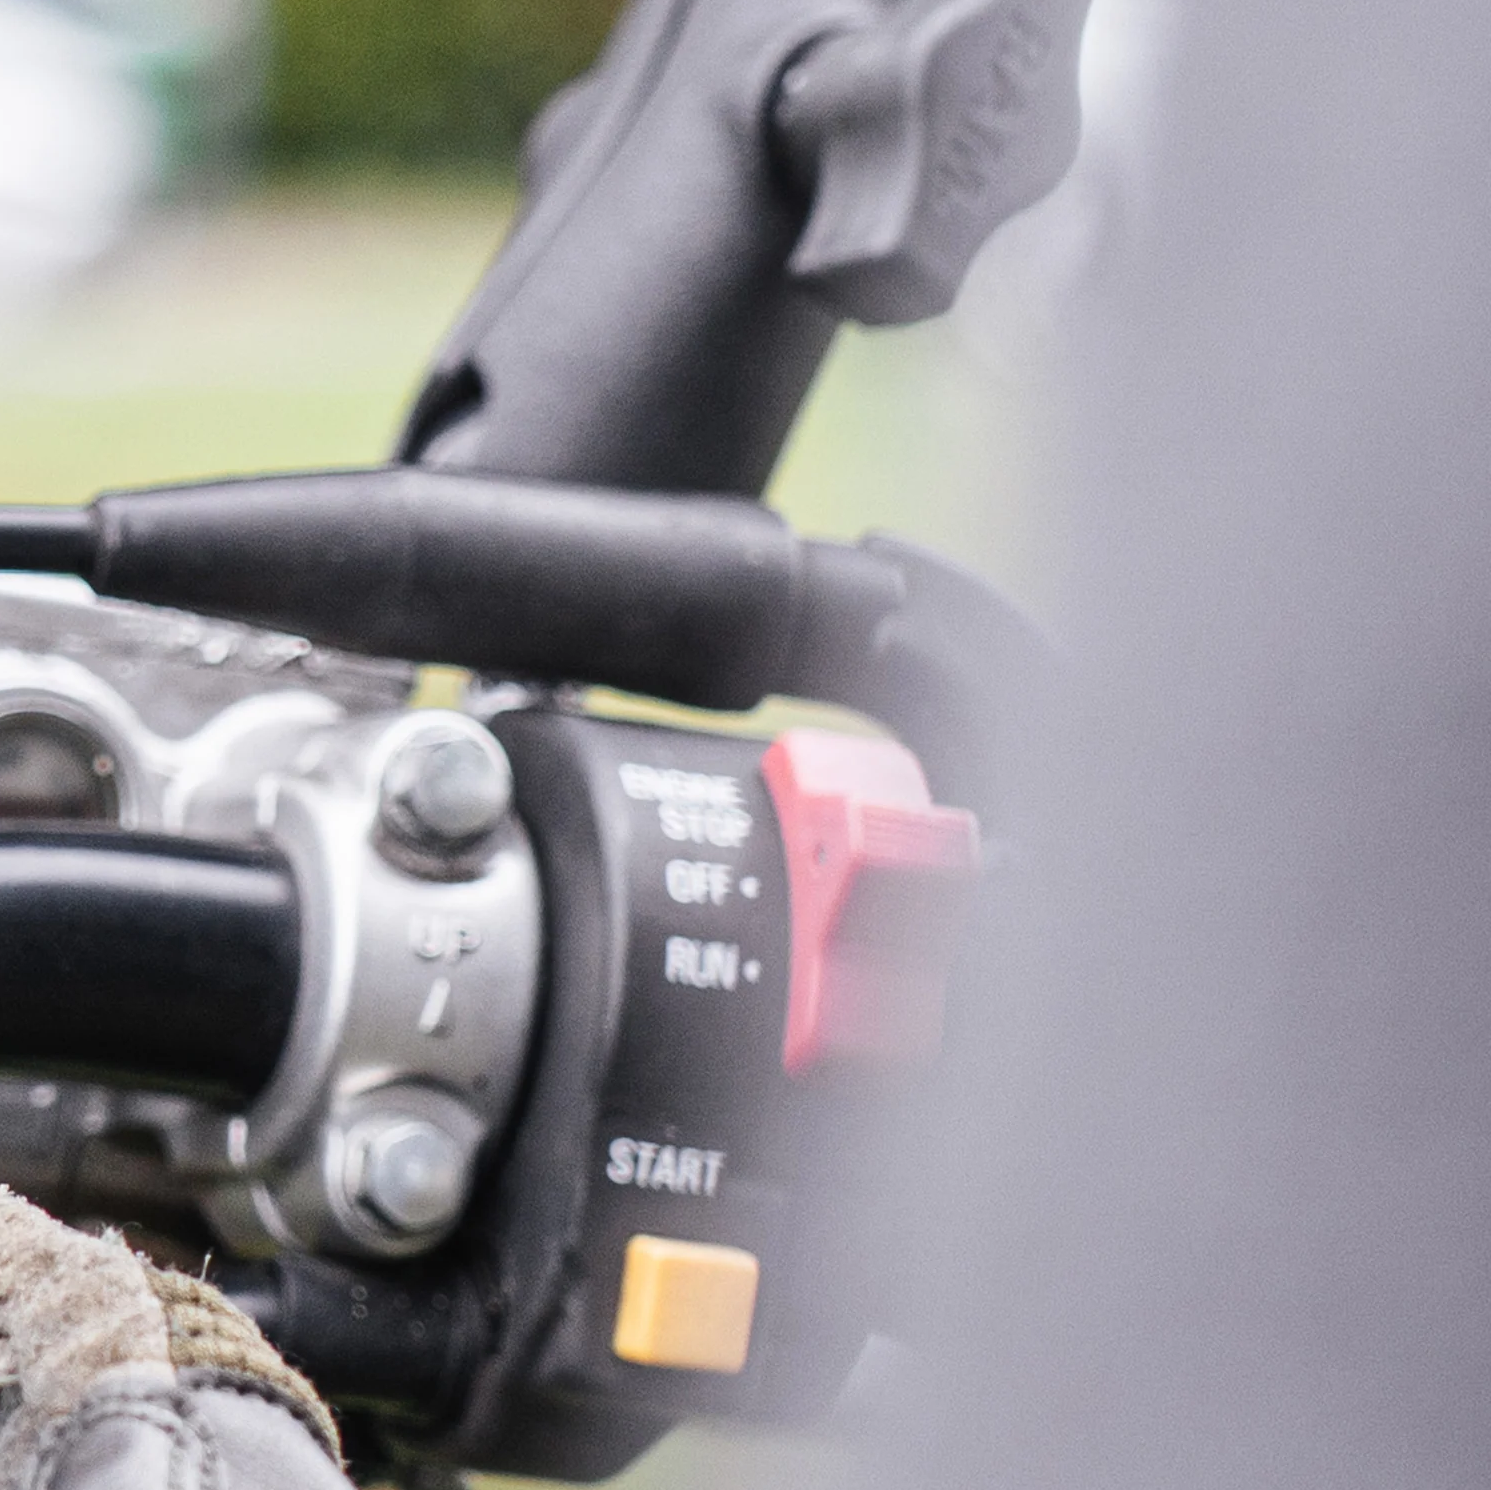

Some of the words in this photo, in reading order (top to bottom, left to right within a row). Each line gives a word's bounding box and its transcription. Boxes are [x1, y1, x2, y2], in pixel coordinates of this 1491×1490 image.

[658, 801, 753, 847] STOP
[665, 859, 734, 905] OFF
[665, 936, 740, 990] RUN
[607, 1136, 726, 1197] START
